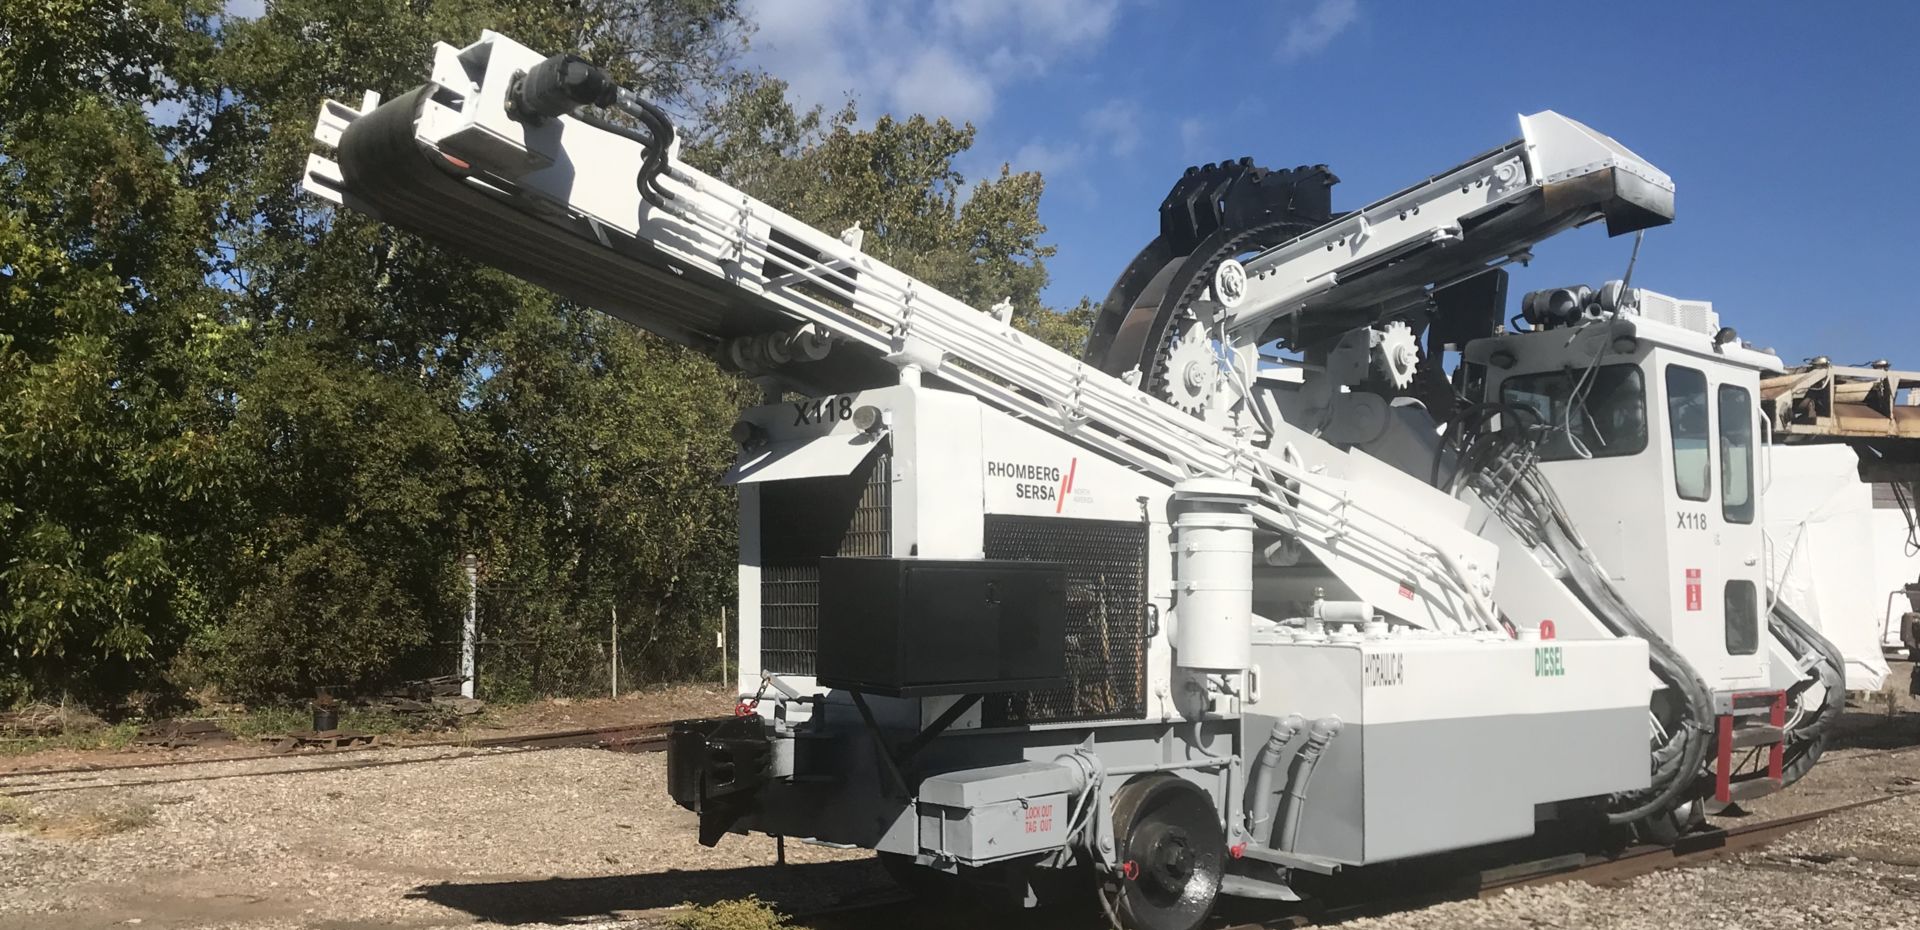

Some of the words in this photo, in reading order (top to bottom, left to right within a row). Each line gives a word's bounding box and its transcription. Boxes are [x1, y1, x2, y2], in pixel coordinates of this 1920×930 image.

[793, 396, 853, 426] X118
[988, 461, 1061, 482] RHOMBERG
[1016, 483, 1056, 501] SERSA
[1677, 511, 1707, 530] X118
[1365, 653, 1397, 687] HYDRAULIC
[1534, 646, 1565, 676] DIESEL
[1025, 806, 1041, 819] LOCK
[1042, 804, 1053, 817] OUT
[1025, 821, 1037, 833] TAG
[1040, 819, 1053, 832] OUT
